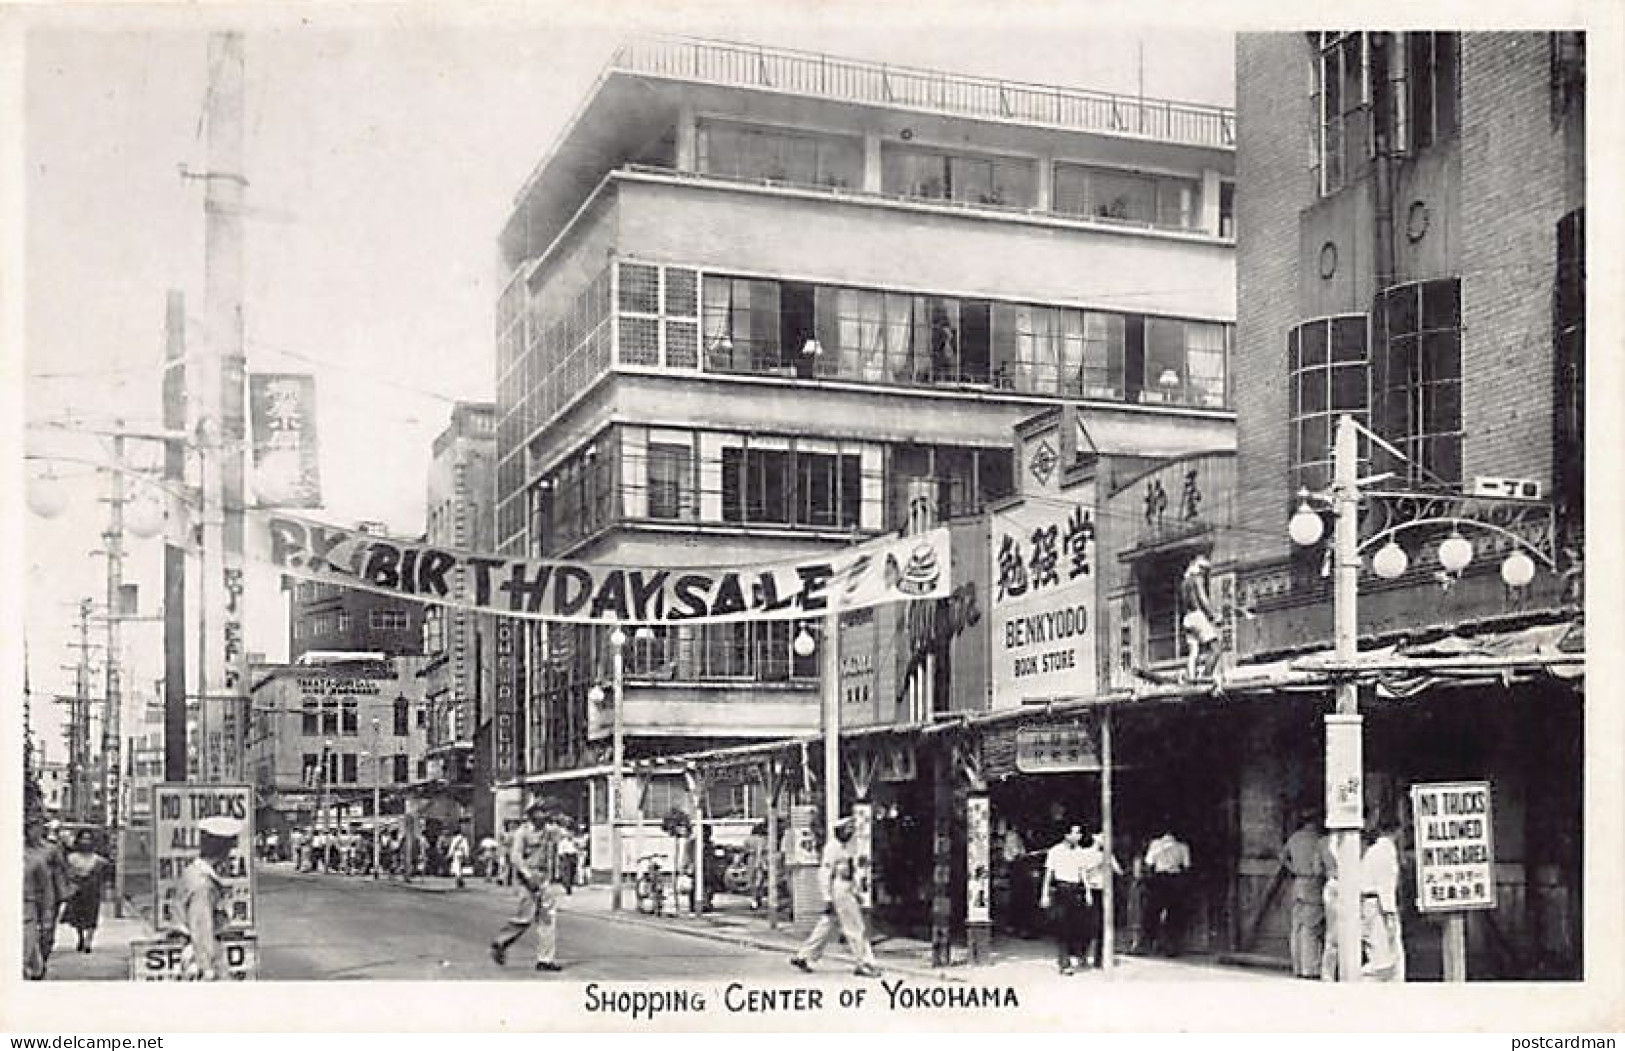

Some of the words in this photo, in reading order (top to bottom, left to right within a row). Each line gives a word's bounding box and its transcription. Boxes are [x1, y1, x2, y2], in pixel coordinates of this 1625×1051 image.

[1481, 480, 1538, 497] 一丁目
[364, 543, 671, 620] BIRTHDAY
[668, 563, 834, 620] SALE
[1005, 605, 1088, 649] BENKYODO
[1014, 655, 1038, 678] BOOK
[1042, 649, 1076, 673] STORE
[159, 794, 181, 820] NO
[188, 794, 246, 820] TRUCKS
[1421, 793, 1438, 816] NO
[1442, 790, 1486, 815] TRUCKS
[1427, 820, 1483, 840] ALLOWED
[146, 945, 245, 971] SPD
